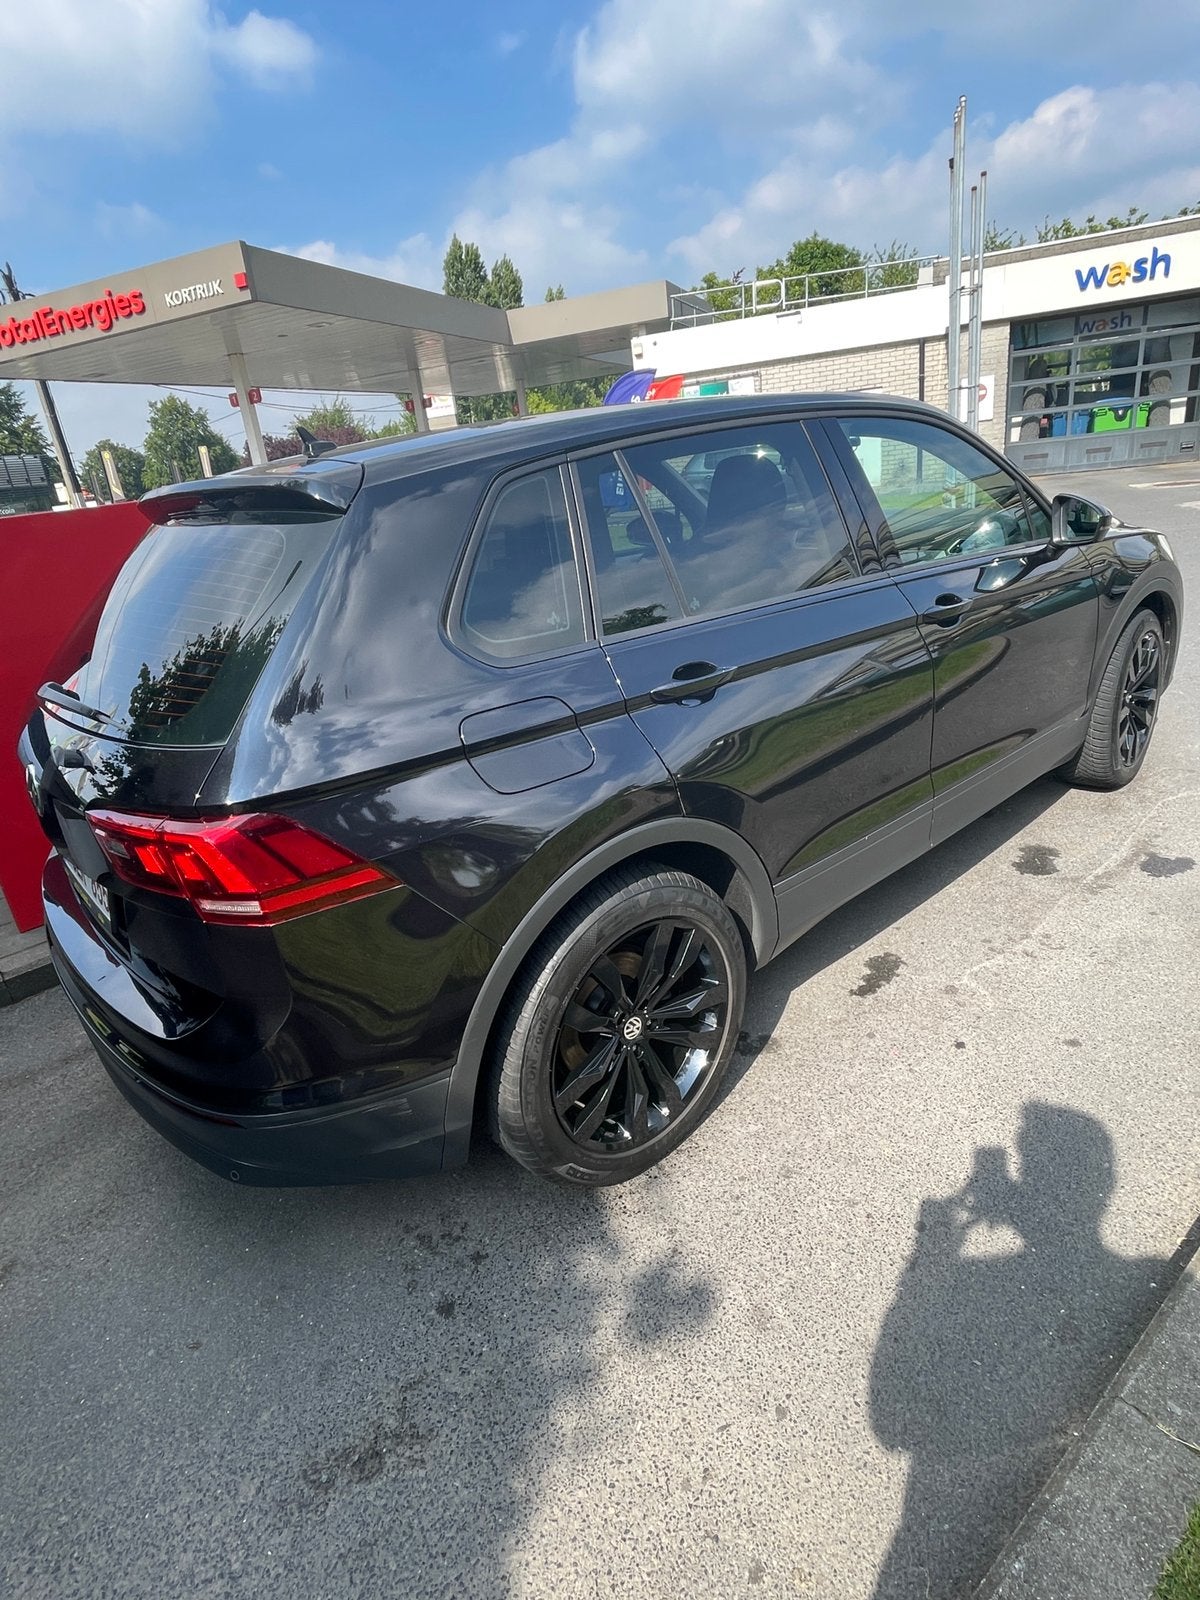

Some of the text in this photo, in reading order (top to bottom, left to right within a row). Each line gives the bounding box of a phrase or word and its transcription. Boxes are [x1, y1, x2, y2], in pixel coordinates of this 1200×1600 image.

[1075, 246, 1172, 291] wash
[164, 279, 223, 307] KORTRIJK
[0, 289, 145, 350] otalEnergies
[1080, 311, 1132, 334] wash
